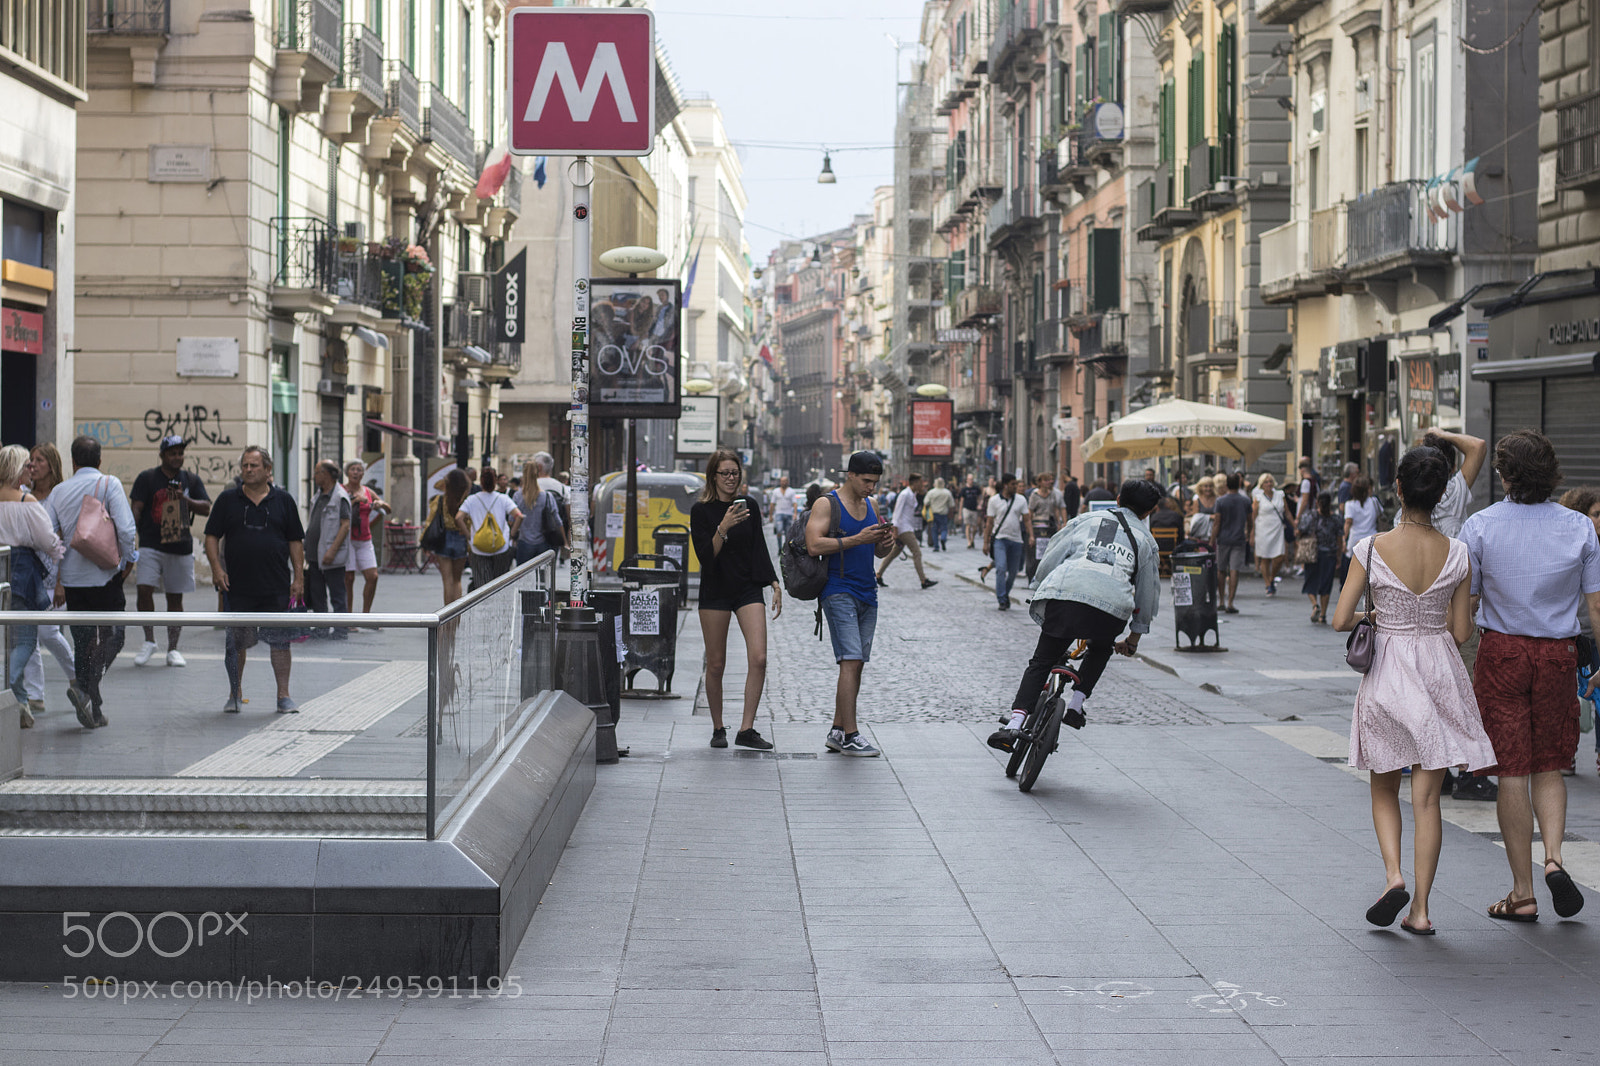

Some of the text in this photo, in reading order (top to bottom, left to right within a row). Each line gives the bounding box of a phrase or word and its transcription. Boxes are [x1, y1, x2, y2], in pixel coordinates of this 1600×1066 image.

[523, 41, 639, 123] M
[626, 256, 651, 264] Toledo
[505, 272, 518, 338] GEOX
[597, 344, 668, 376] OVS
[1410, 360, 1434, 391] SALDI
[1204, 424, 1232, 435] ROMA
